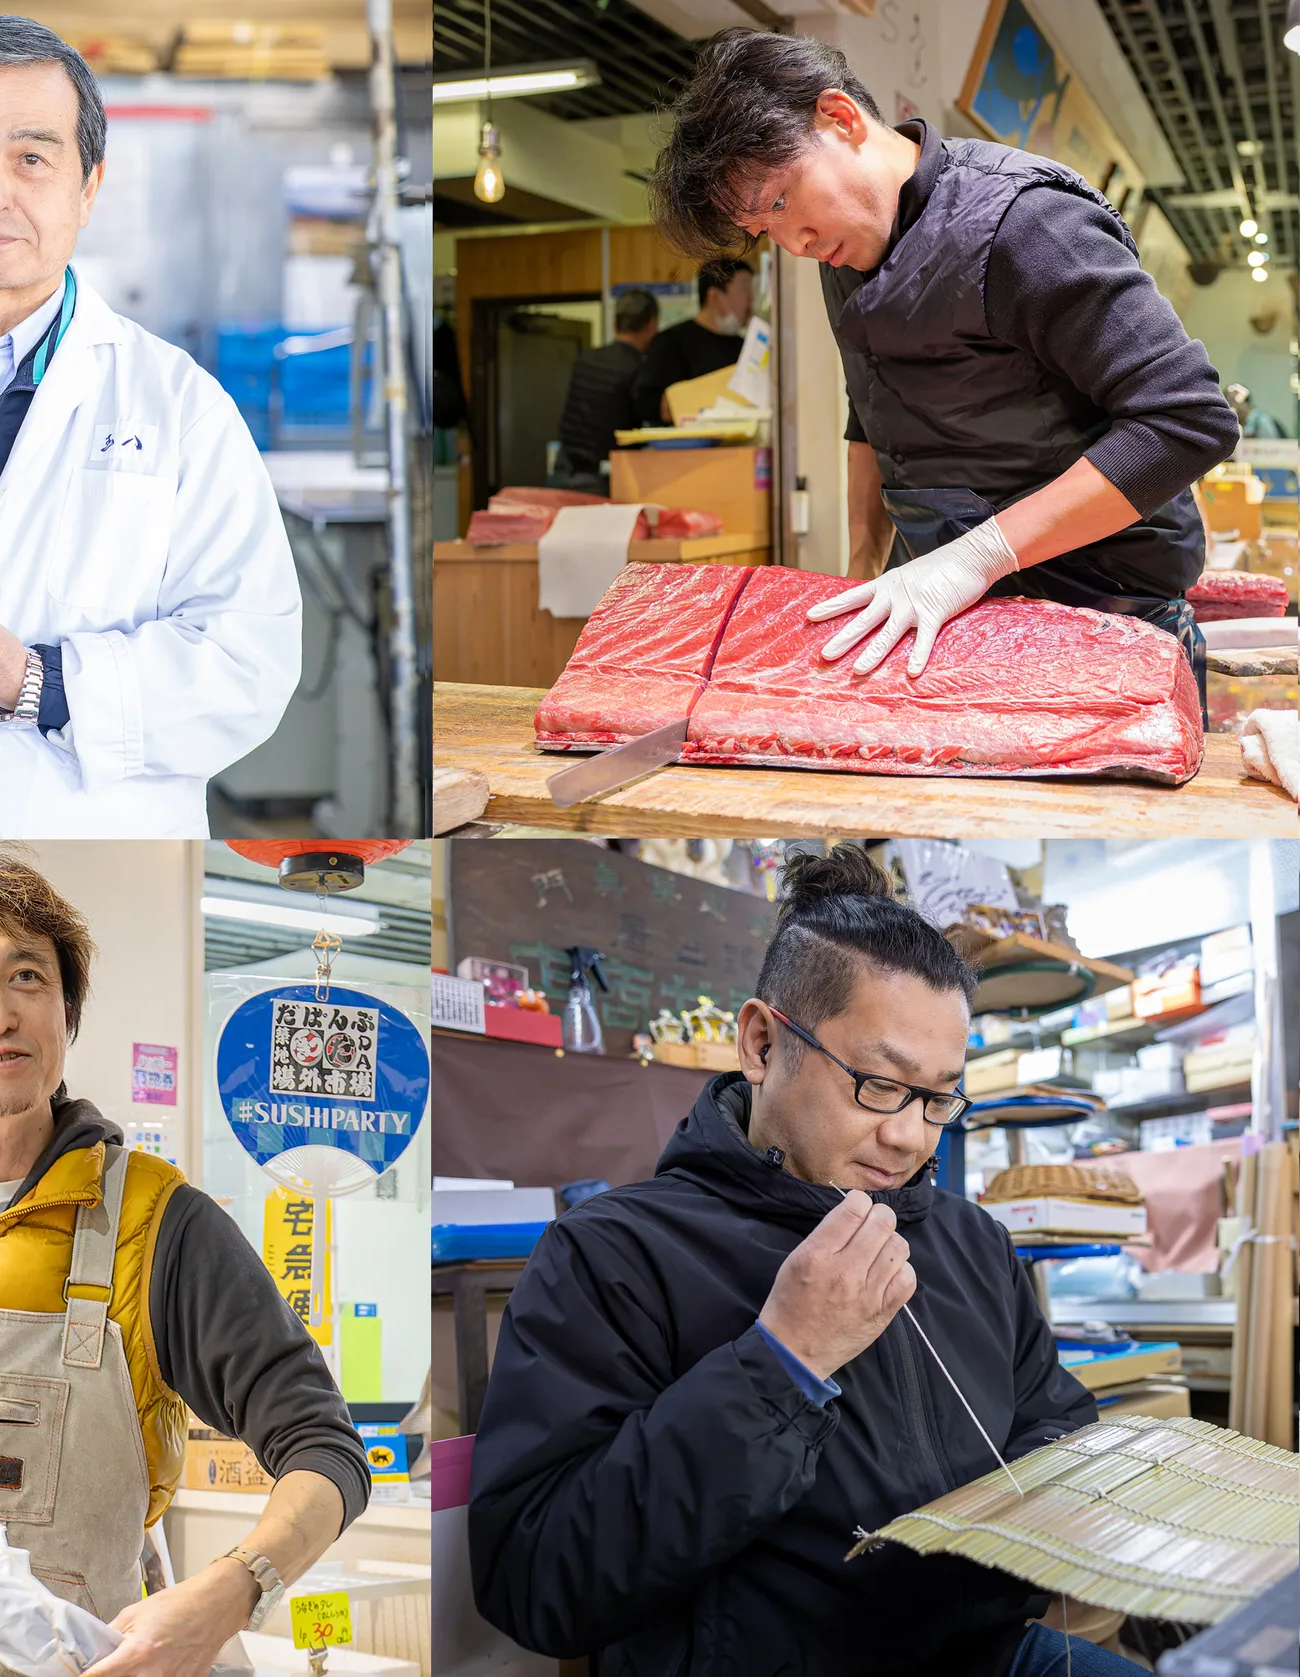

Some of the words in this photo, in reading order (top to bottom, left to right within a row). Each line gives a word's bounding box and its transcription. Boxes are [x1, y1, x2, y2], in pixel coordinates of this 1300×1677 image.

[275, 1003, 375, 1033] だぱんぷ
[272, 1064, 372, 1097] 場外市場
[238, 1100, 409, 1134] #SUSHIPARTY
[312, 1622, 334, 1641] 30
